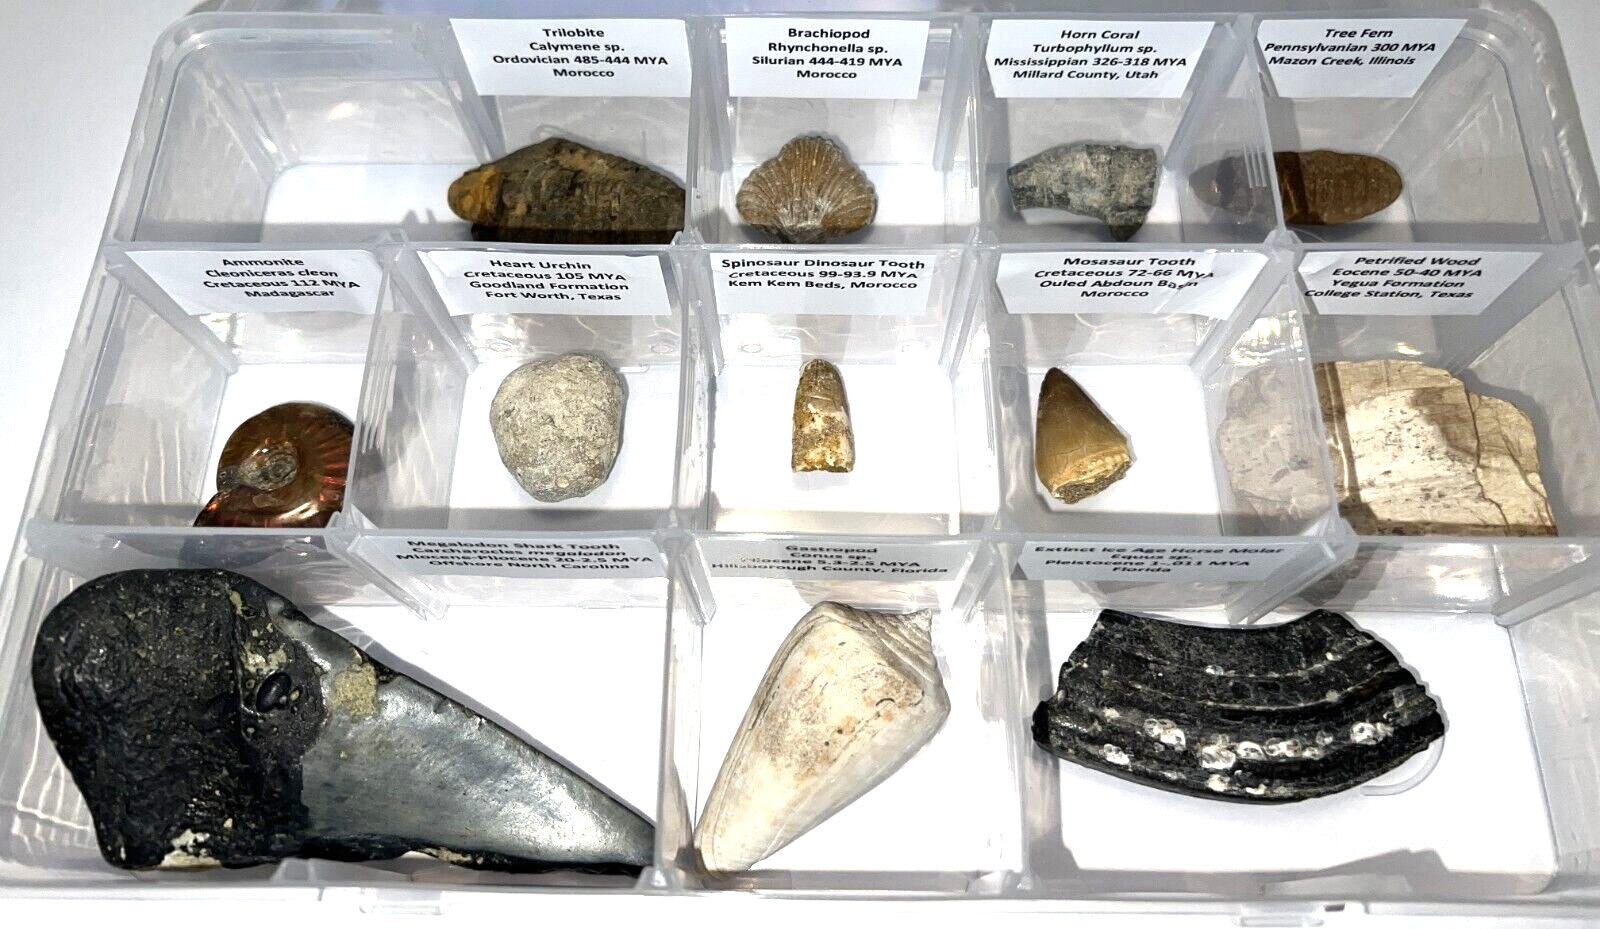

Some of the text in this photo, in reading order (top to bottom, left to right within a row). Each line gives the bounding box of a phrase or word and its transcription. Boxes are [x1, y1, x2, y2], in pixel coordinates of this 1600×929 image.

[542, 28, 605, 37] Trilobite
[788, 28, 870, 40] Brachiopod
[1060, 30, 1140, 39] Horn Coral
[1324, 29, 1393, 38] Tree Fern
[530, 42, 625, 53] Calymene sp.
[768, 42, 888, 55] Rhynchonella sp.
[1033, 44, 1157, 54] Turbophyllum sp.
[1264, 43, 1436, 54] Pennsylvanian 300 MYA
[493, 55, 668, 65] Ordovician 485-444 MYA
[752, 56, 902, 66] Silurian 444-419 MYA
[994, 58, 1187, 67] Mississippian 326-318 MYA
[1268, 56, 1416, 66] Mazon Creek, Illinois
[553, 69, 615, 77] Morocco
[796, 70, 857, 79] Morocco
[1013, 70, 1159, 80] Millard County, Utah
[490, 260, 592, 269] Heart Urchin
[721, 259, 925, 269] Spinosaur Dinosaur Tooth
[1063, 258, 1195, 266] Mosasaur Tooth
[1354, 257, 1481, 266] Petrified Wood
[205, 269, 339, 277] Cleoniceras cleon
[464, 271, 626, 281] Cretaceous 105 MYA
[729, 270, 815, 279] Cretaceous
[880, 271, 918, 279] MYA
[1034, 269, 1123, 278] Cretaceous
[1176, 269, 1214, 279] MYA
[1332, 268, 1482, 277] Eocene 50-40 MYA
[203, 279, 361, 288] Cretaceous 112 MYA
[470, 281, 629, 290] Goodland Formation
[805, 281, 845, 290] Beds,
[850, 281, 918, 289] Morocco
[1157, 280, 1198, 290] Basin
[1332, 280, 1465, 288] Yegua Formation
[244, 290, 335, 298] Madagascar
[520, 292, 575, 301] Worth,
[577, 293, 622, 301] Texas
[1080, 290, 1149, 298] Morocco
[1304, 290, 1360, 298] College
[1364, 290, 1423, 298] Station,
[412, 547, 523, 555] Carcharocles
[785, 545, 878, 554] Gastropod
[396, 554, 549, 562] Miocene-Pliocene
